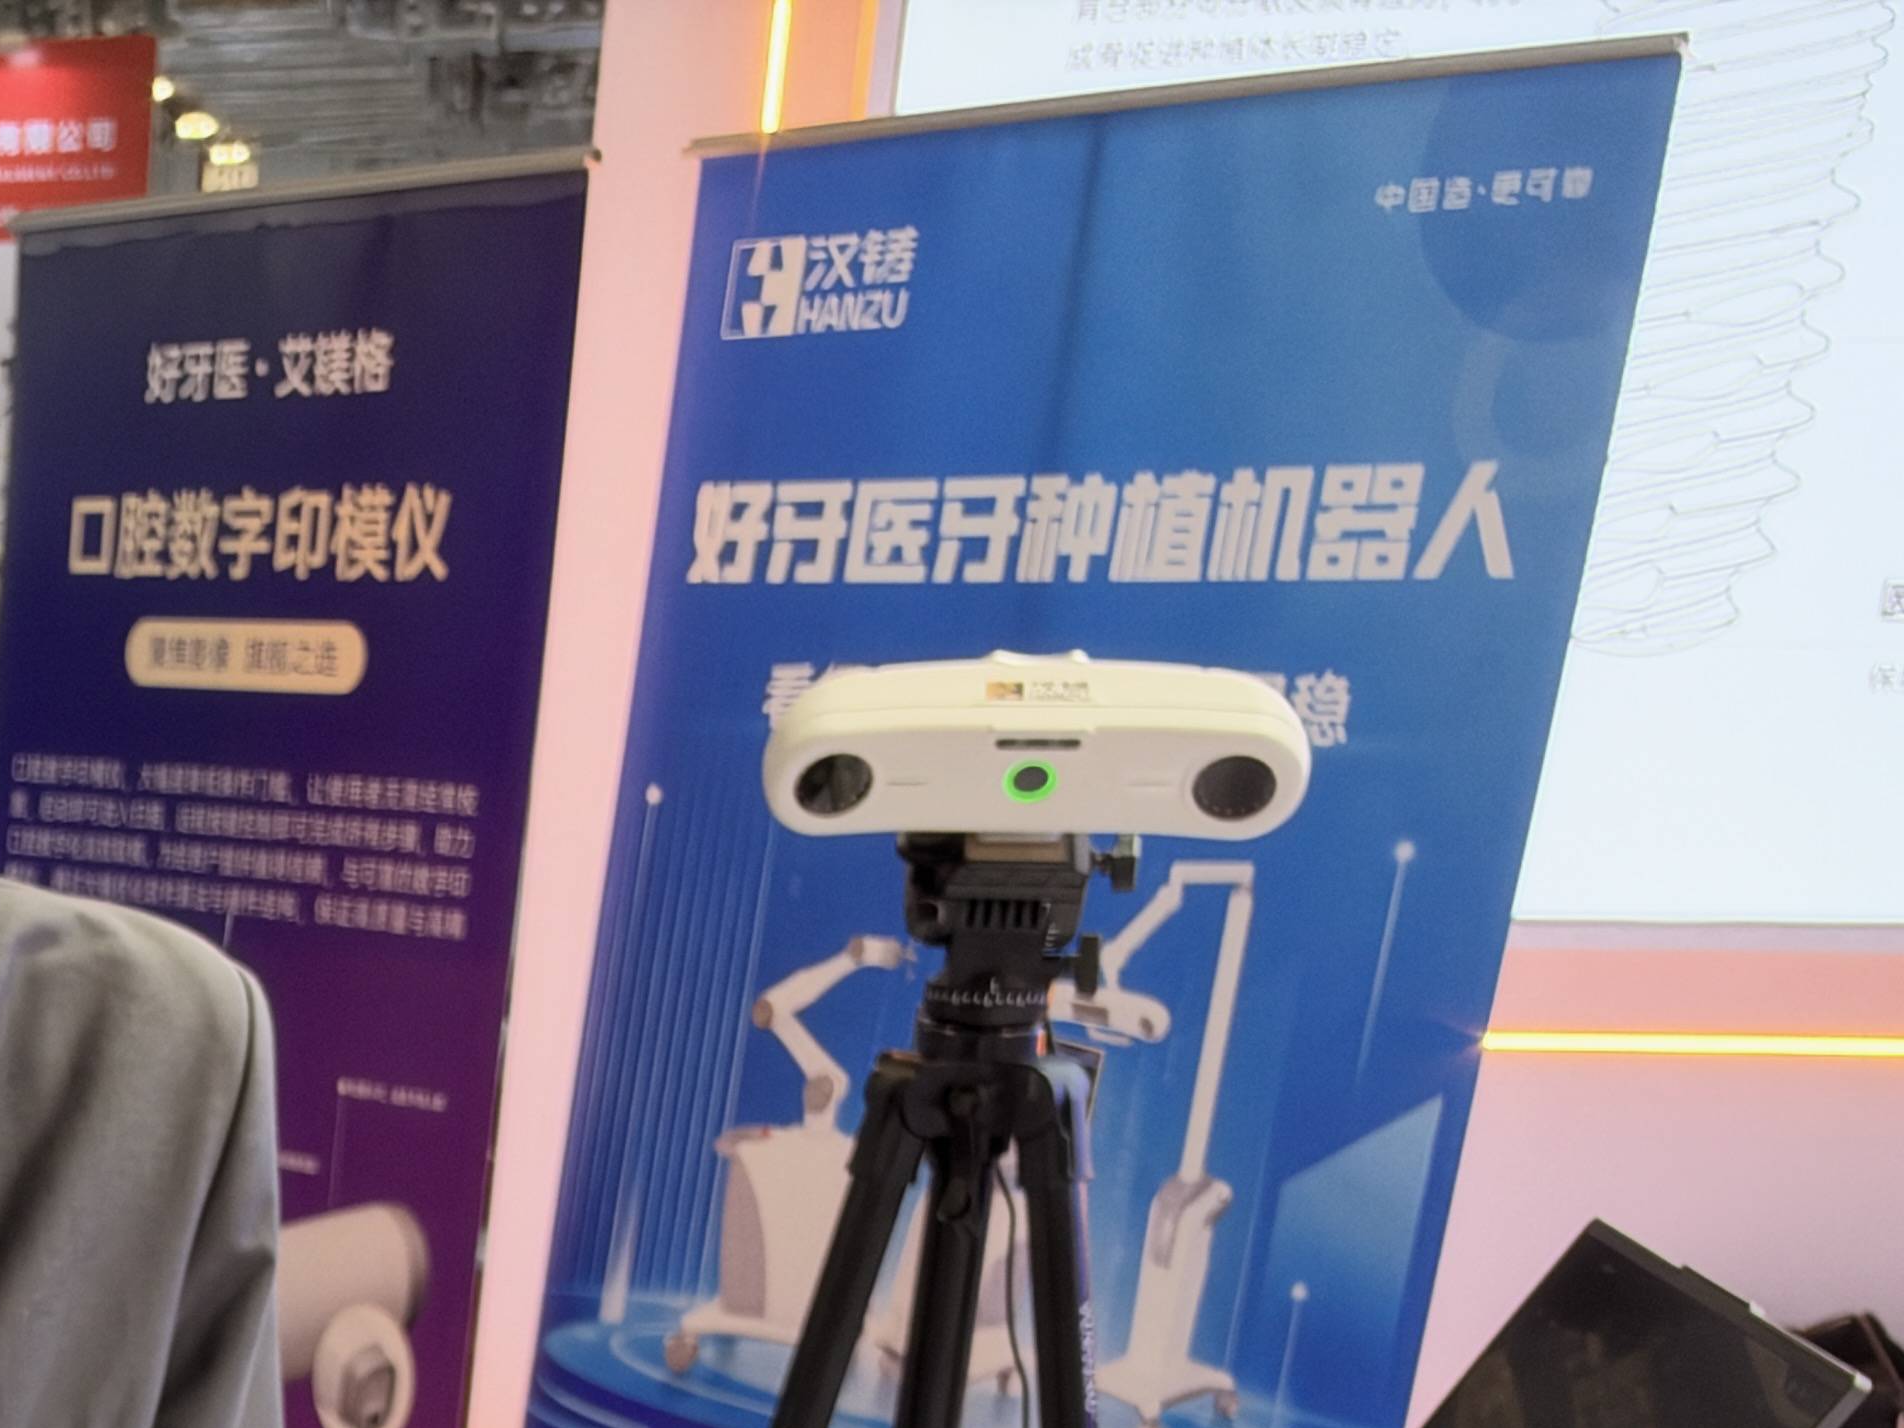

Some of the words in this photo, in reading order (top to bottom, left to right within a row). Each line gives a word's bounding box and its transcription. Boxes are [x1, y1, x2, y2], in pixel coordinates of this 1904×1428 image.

[796, 287, 910, 334] HANZU
[68, 482, 451, 582] 口腔数字印模仪
[686, 461, 1517, 586] 好牙医牙种植机器人
